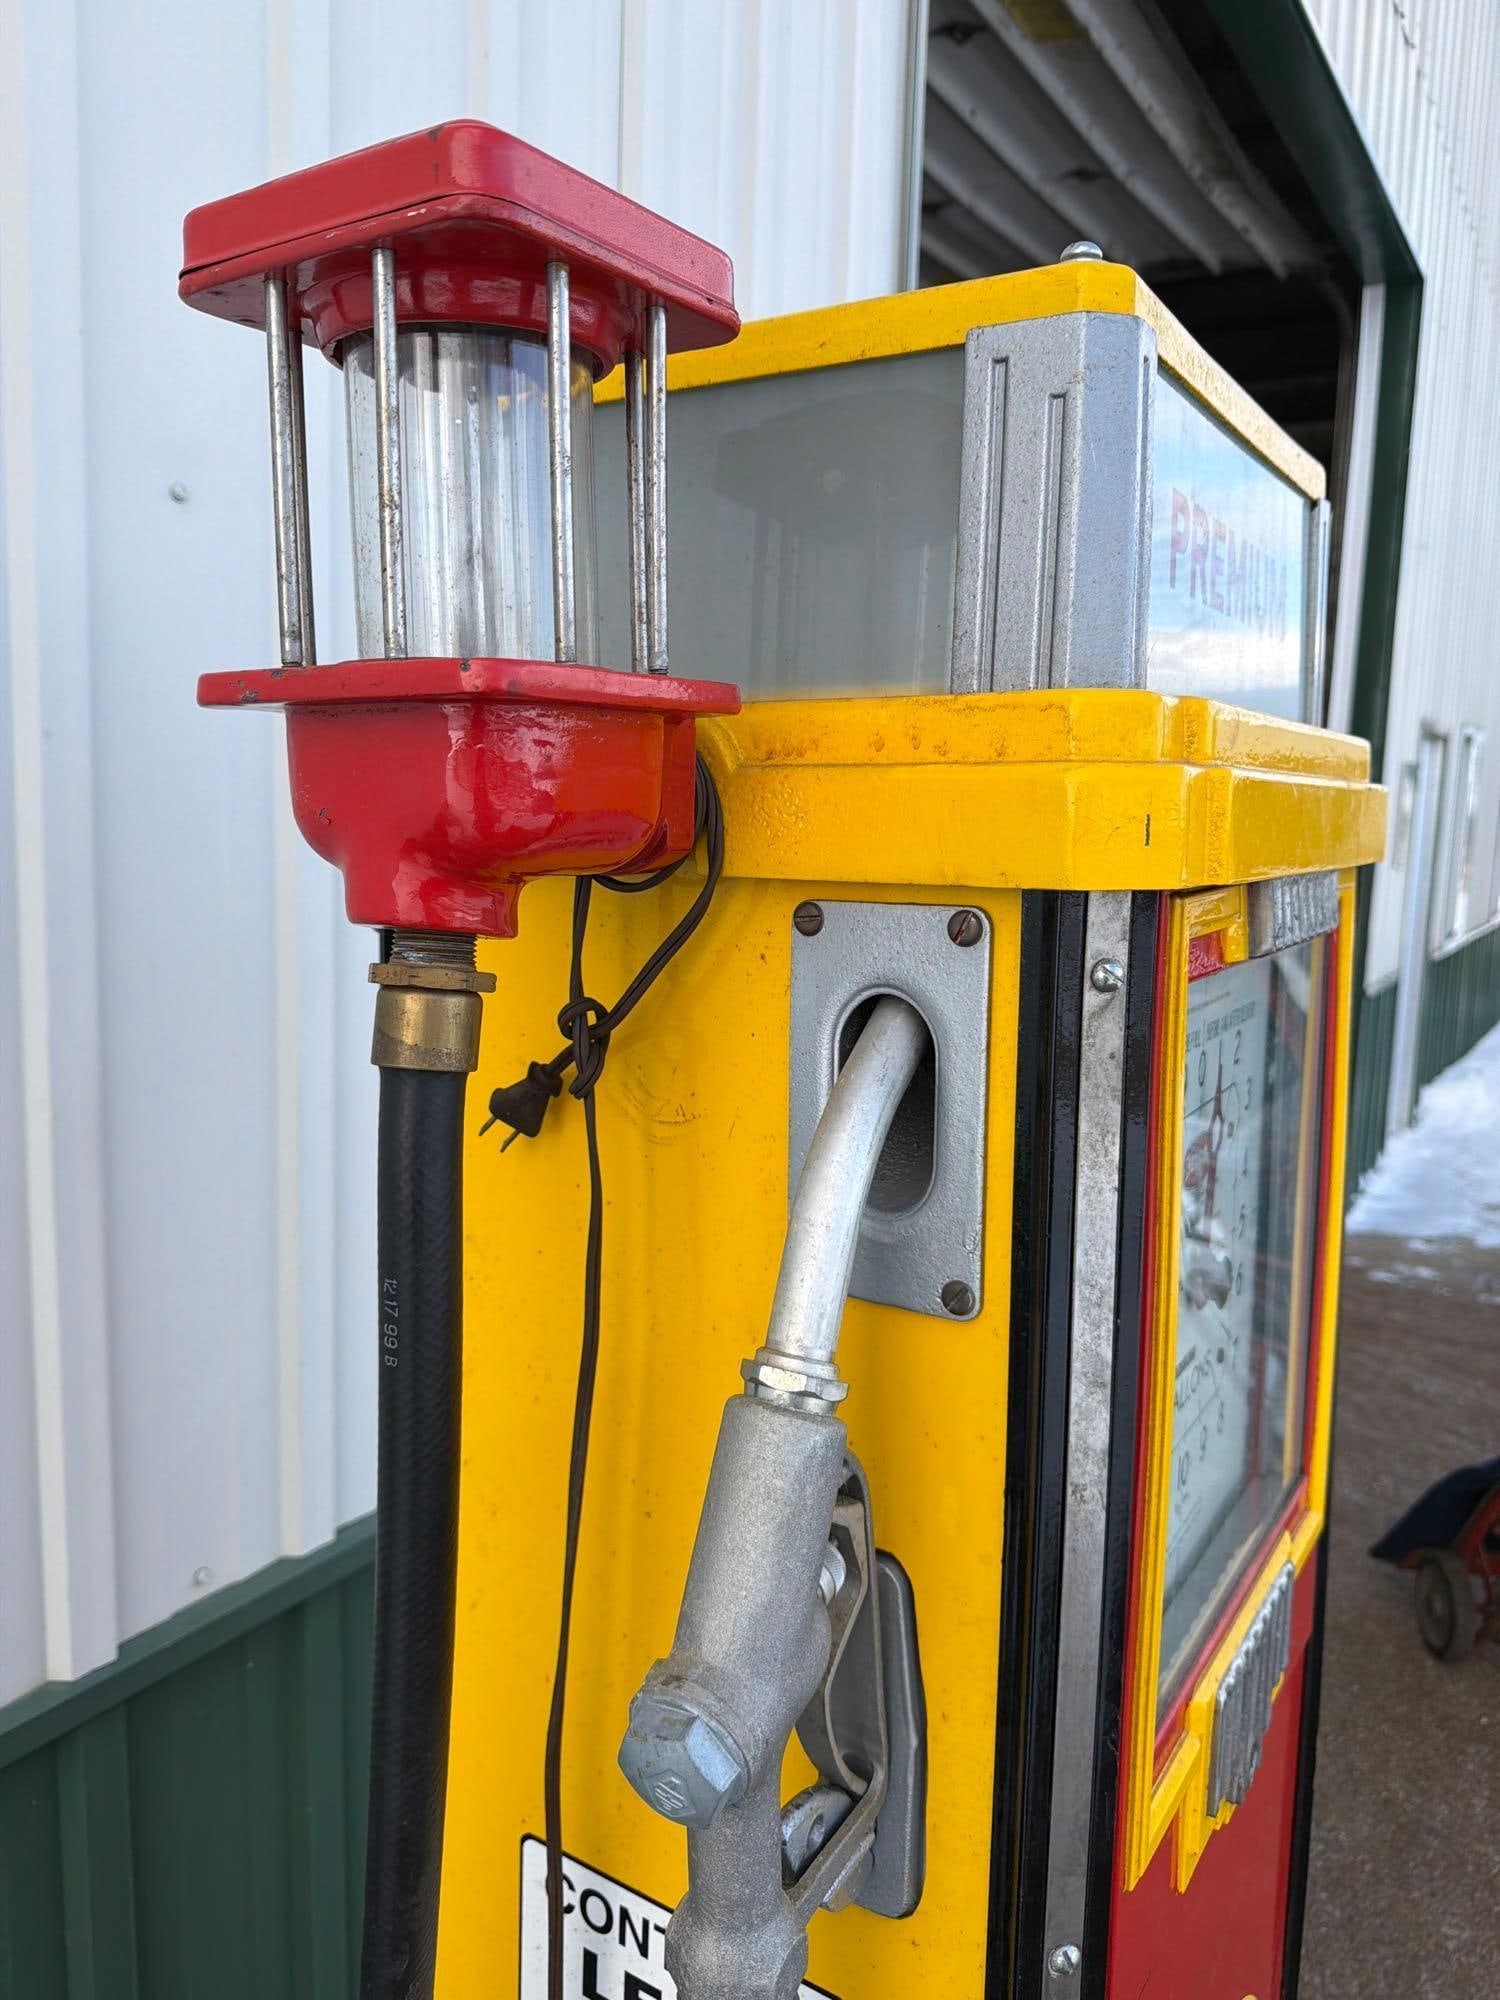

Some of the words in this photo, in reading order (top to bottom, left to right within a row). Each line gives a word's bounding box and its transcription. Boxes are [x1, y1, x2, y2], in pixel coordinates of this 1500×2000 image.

[1170, 487, 1286, 643] PREMIUM
[1233, 1029, 1241, 1065] 2
[384, 1278, 398, 1295] 12
[1235, 1262, 1243, 1297] 6
[384, 1300, 399, 1318] 17
[384, 1323, 398, 1350] 99
[546, 1872, 666, 1960] CON
